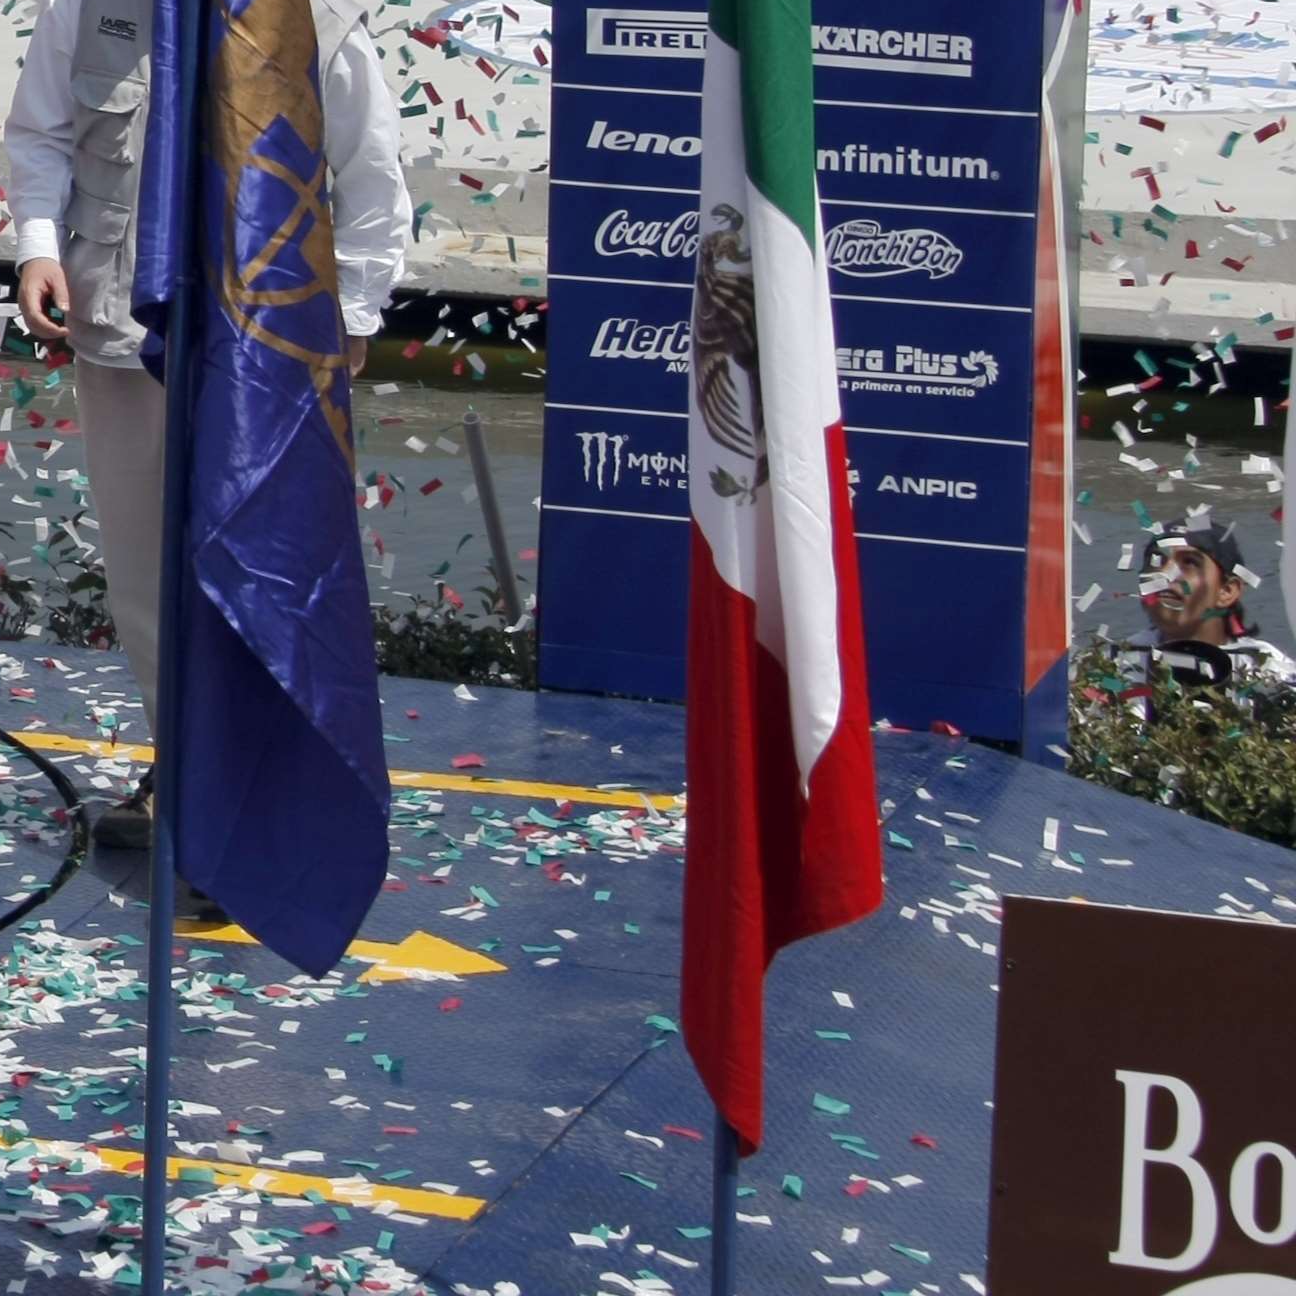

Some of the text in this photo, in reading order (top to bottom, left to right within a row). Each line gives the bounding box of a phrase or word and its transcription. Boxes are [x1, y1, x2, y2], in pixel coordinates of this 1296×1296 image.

[810, 24, 973, 61] KÄRCHER
[586, 121, 703, 158] leno
[816, 143, 988, 180] nfinitum
[826, 230, 964, 275] LonchiBon
[589, 317, 692, 361] Hert
[896, 344, 958, 376] Plus
[852, 380, 976, 398] primera en servicio
[876, 474, 978, 500] ANPIC
